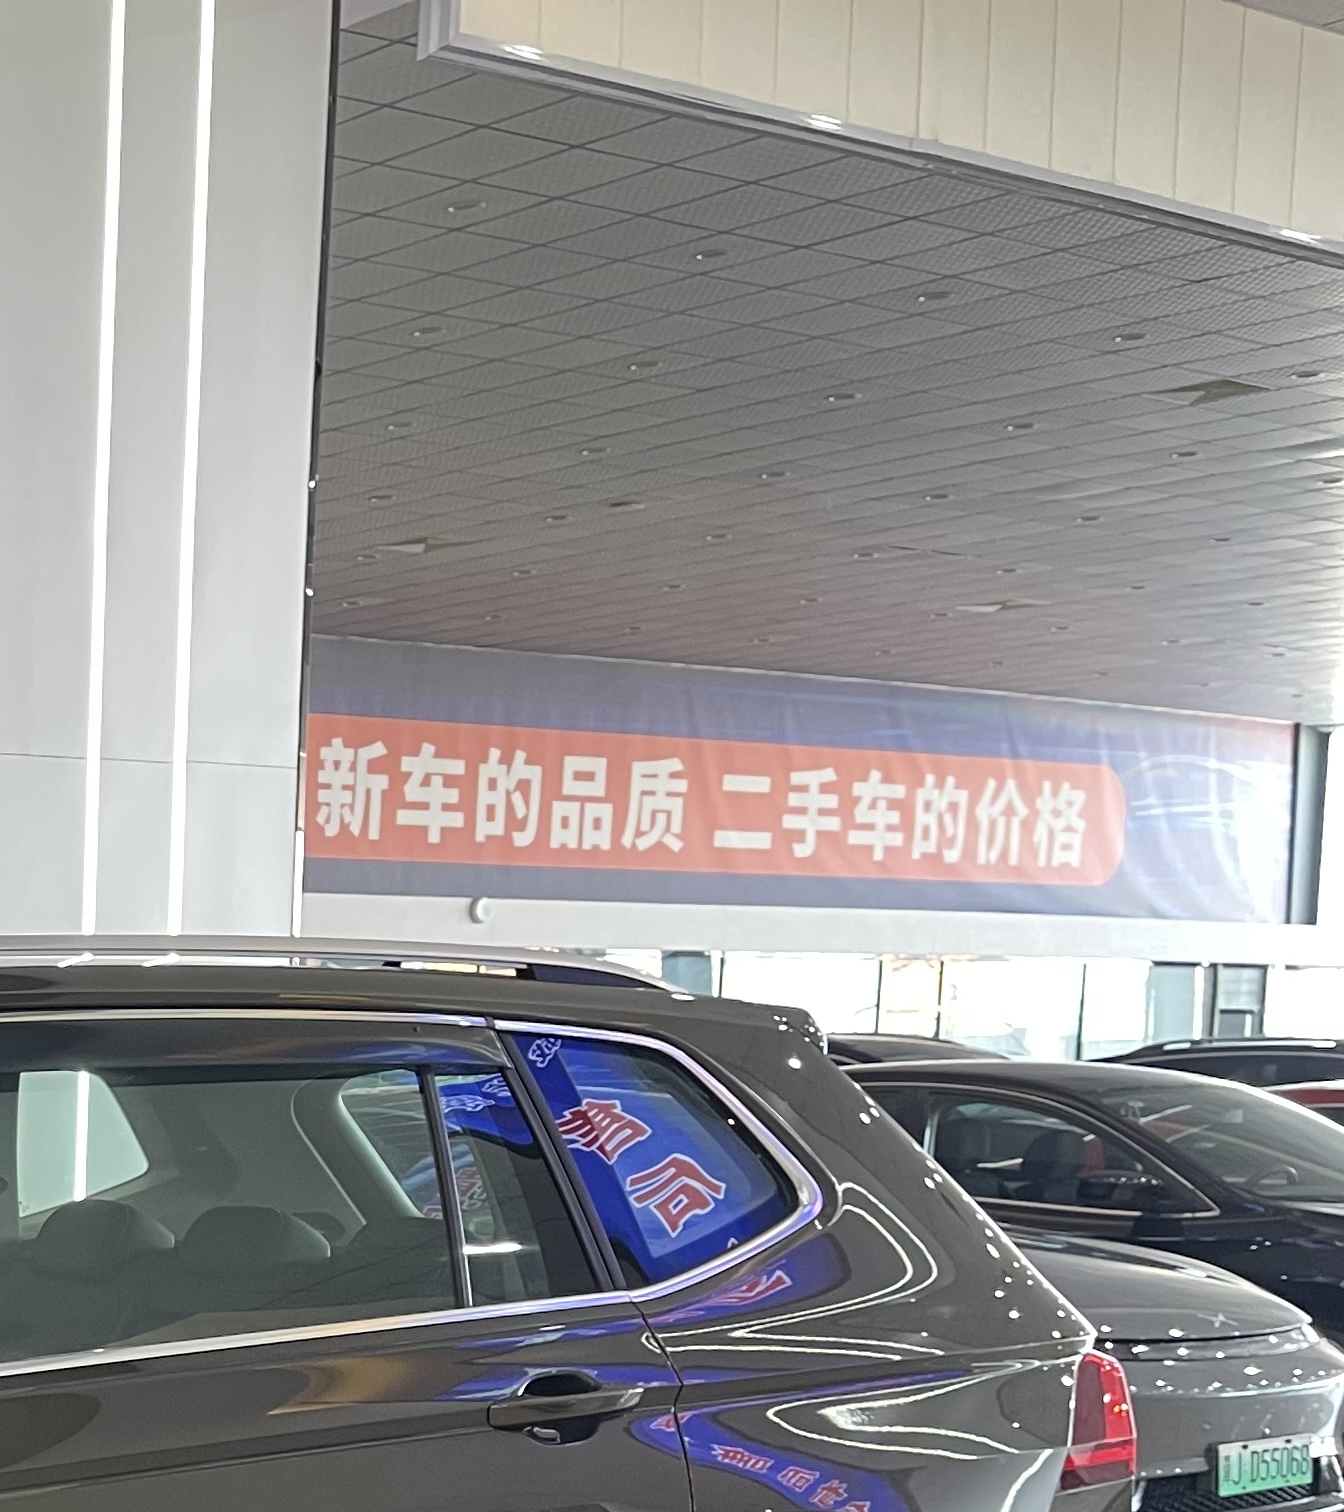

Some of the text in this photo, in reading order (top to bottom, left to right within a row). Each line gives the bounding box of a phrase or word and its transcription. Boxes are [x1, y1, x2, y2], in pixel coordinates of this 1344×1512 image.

[313, 736, 1086, 869] 新车的品质 二手车的价格
